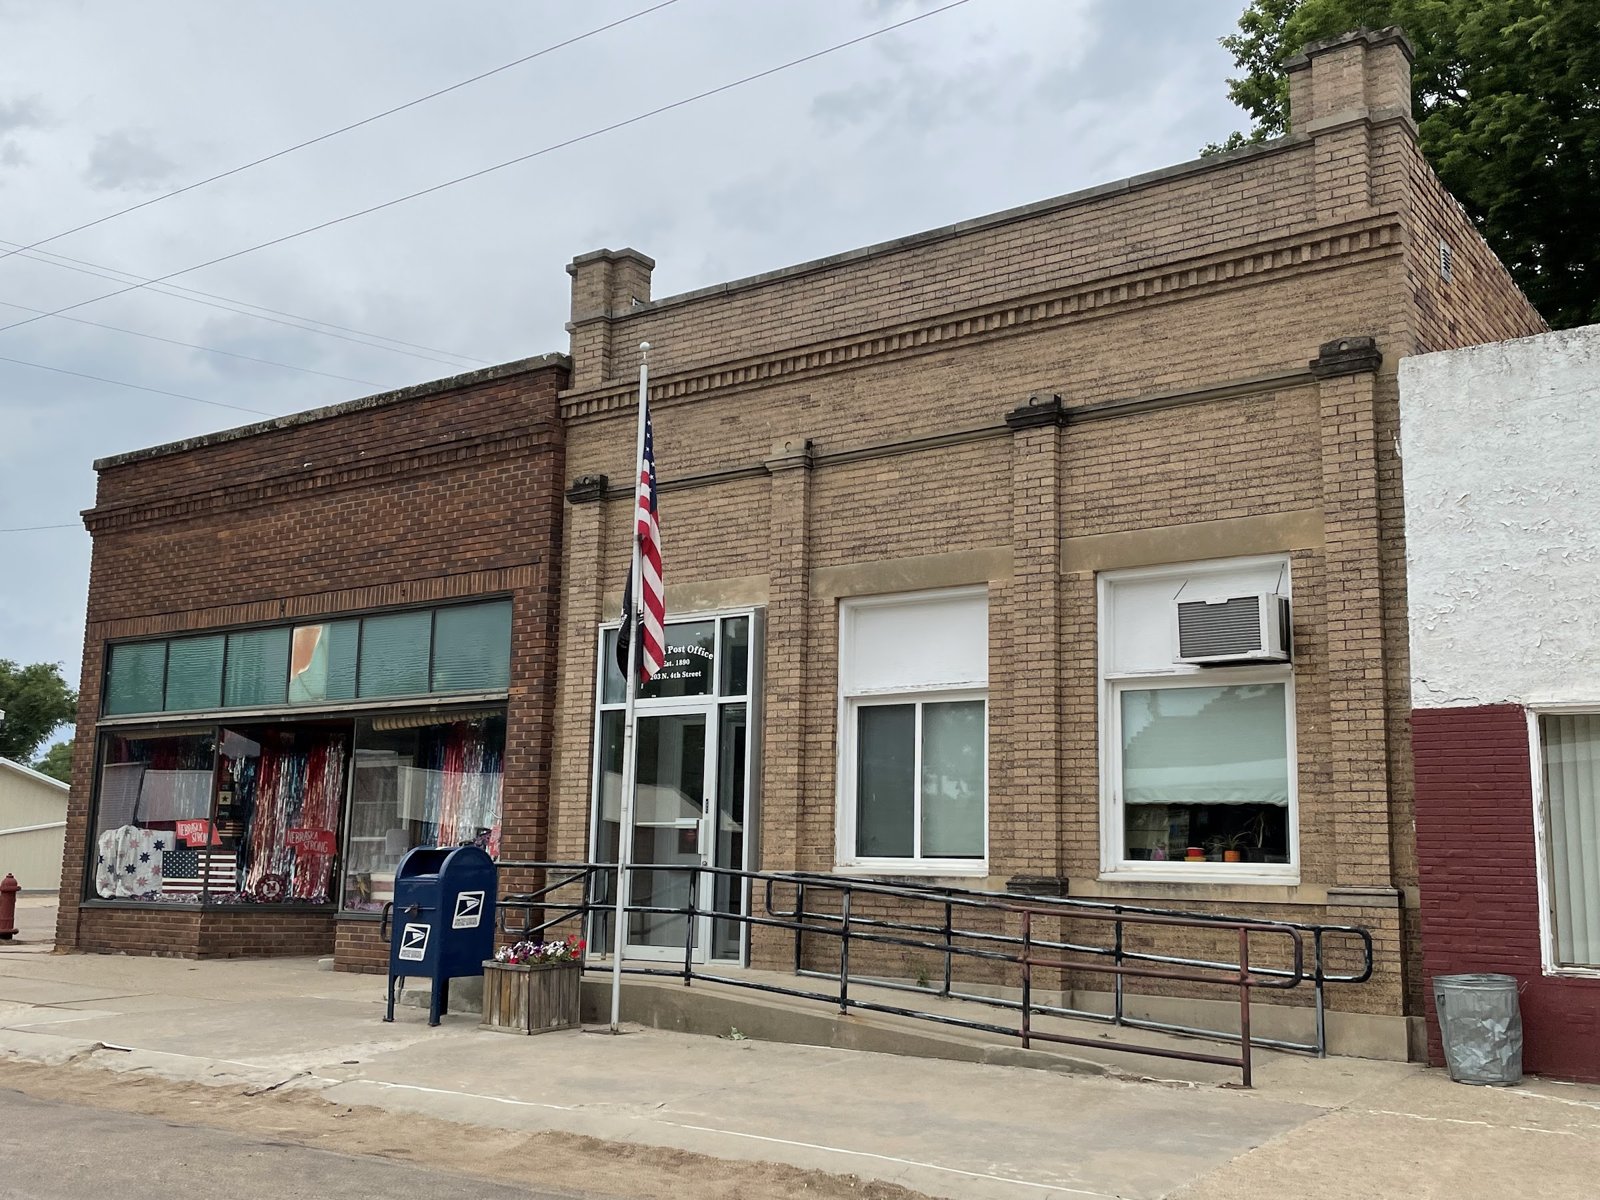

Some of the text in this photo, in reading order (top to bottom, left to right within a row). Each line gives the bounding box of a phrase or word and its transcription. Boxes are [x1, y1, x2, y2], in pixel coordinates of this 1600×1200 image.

[667, 645, 686, 654] Post
[687, 645, 714, 660] Office
[670, 671, 681, 679] 4th
[177, 822, 203, 836] NEBRASKA
[191, 831, 209, 844] STRON
[286, 829, 319, 844] NEBRASKA
[303, 840, 329, 853] STRONG
